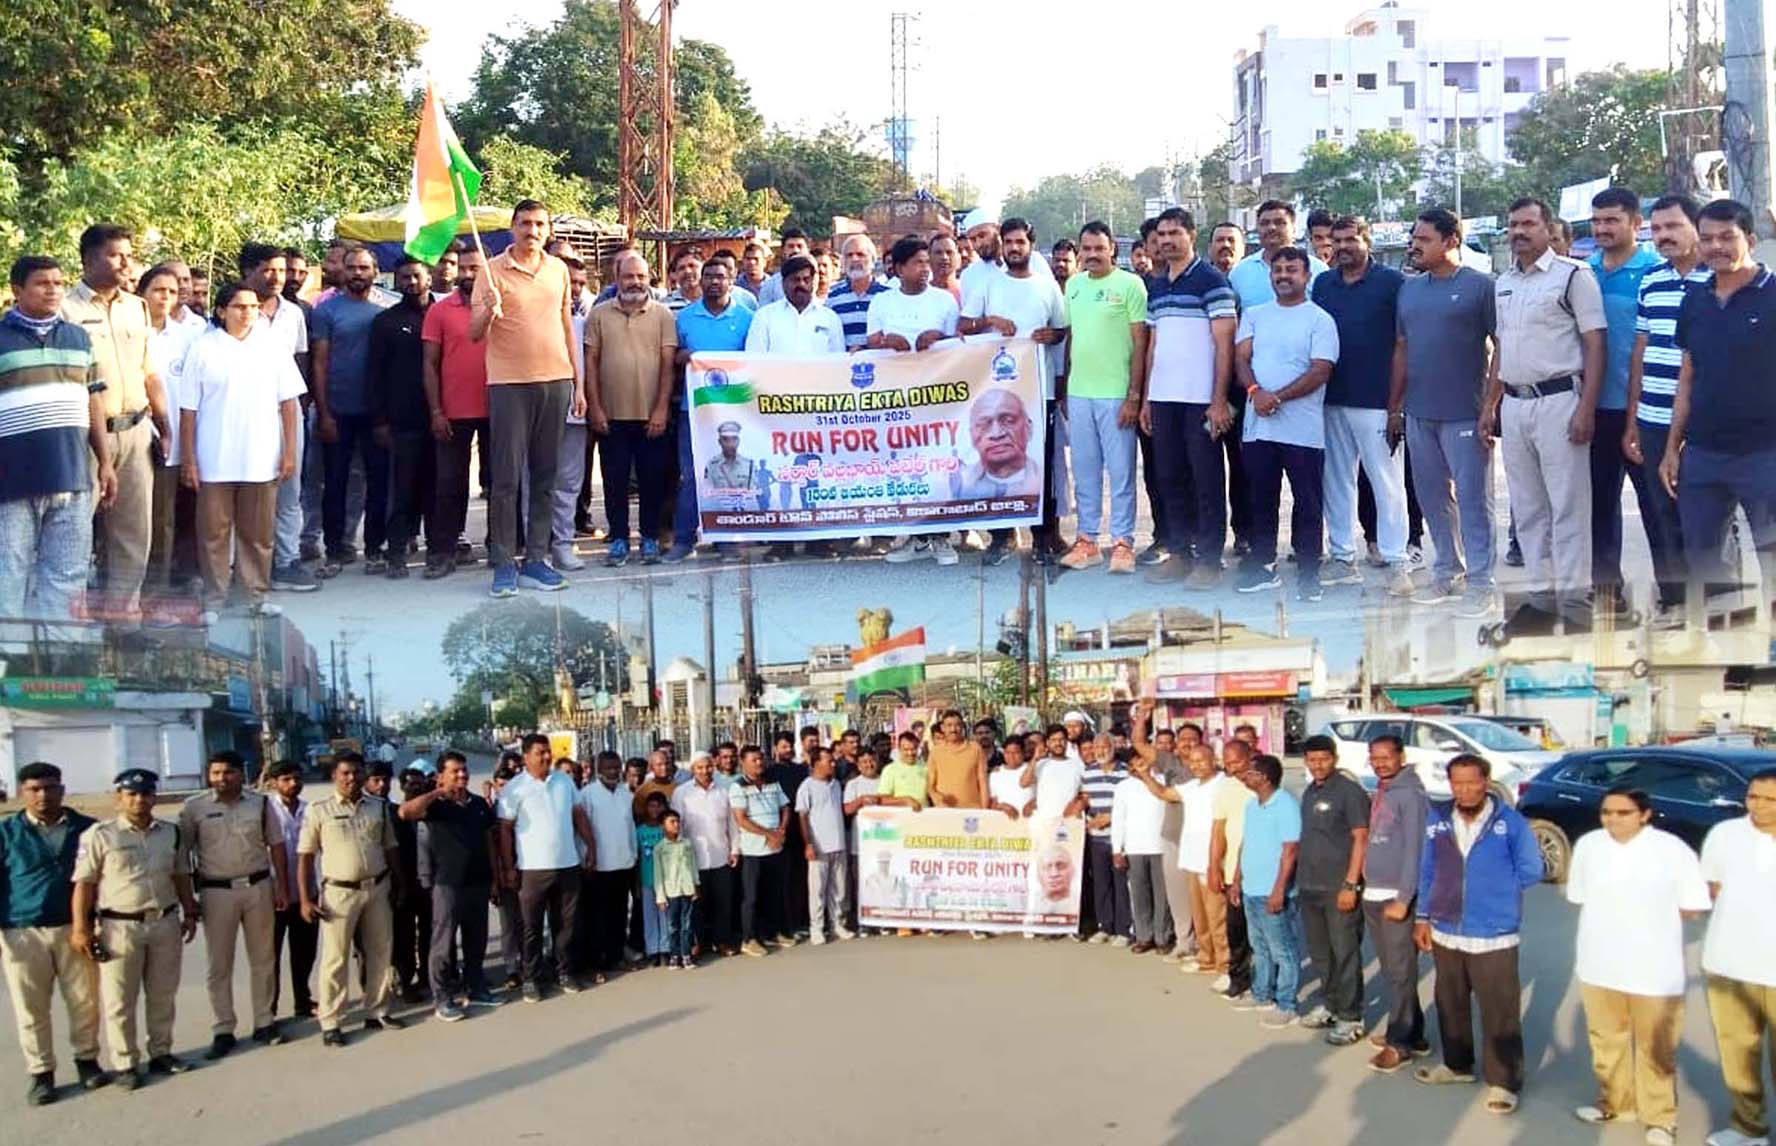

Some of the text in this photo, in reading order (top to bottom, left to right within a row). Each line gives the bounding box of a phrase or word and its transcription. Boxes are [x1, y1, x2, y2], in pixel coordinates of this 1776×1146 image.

[759, 381, 969, 414] RASHTRIYA EKTA DIWAS
[816, 410, 911, 426] 31st October 2025
[772, 421, 960, 456] RUN FOR UNITY
[910, 860, 1030, 878] RUN FOR UNITY
